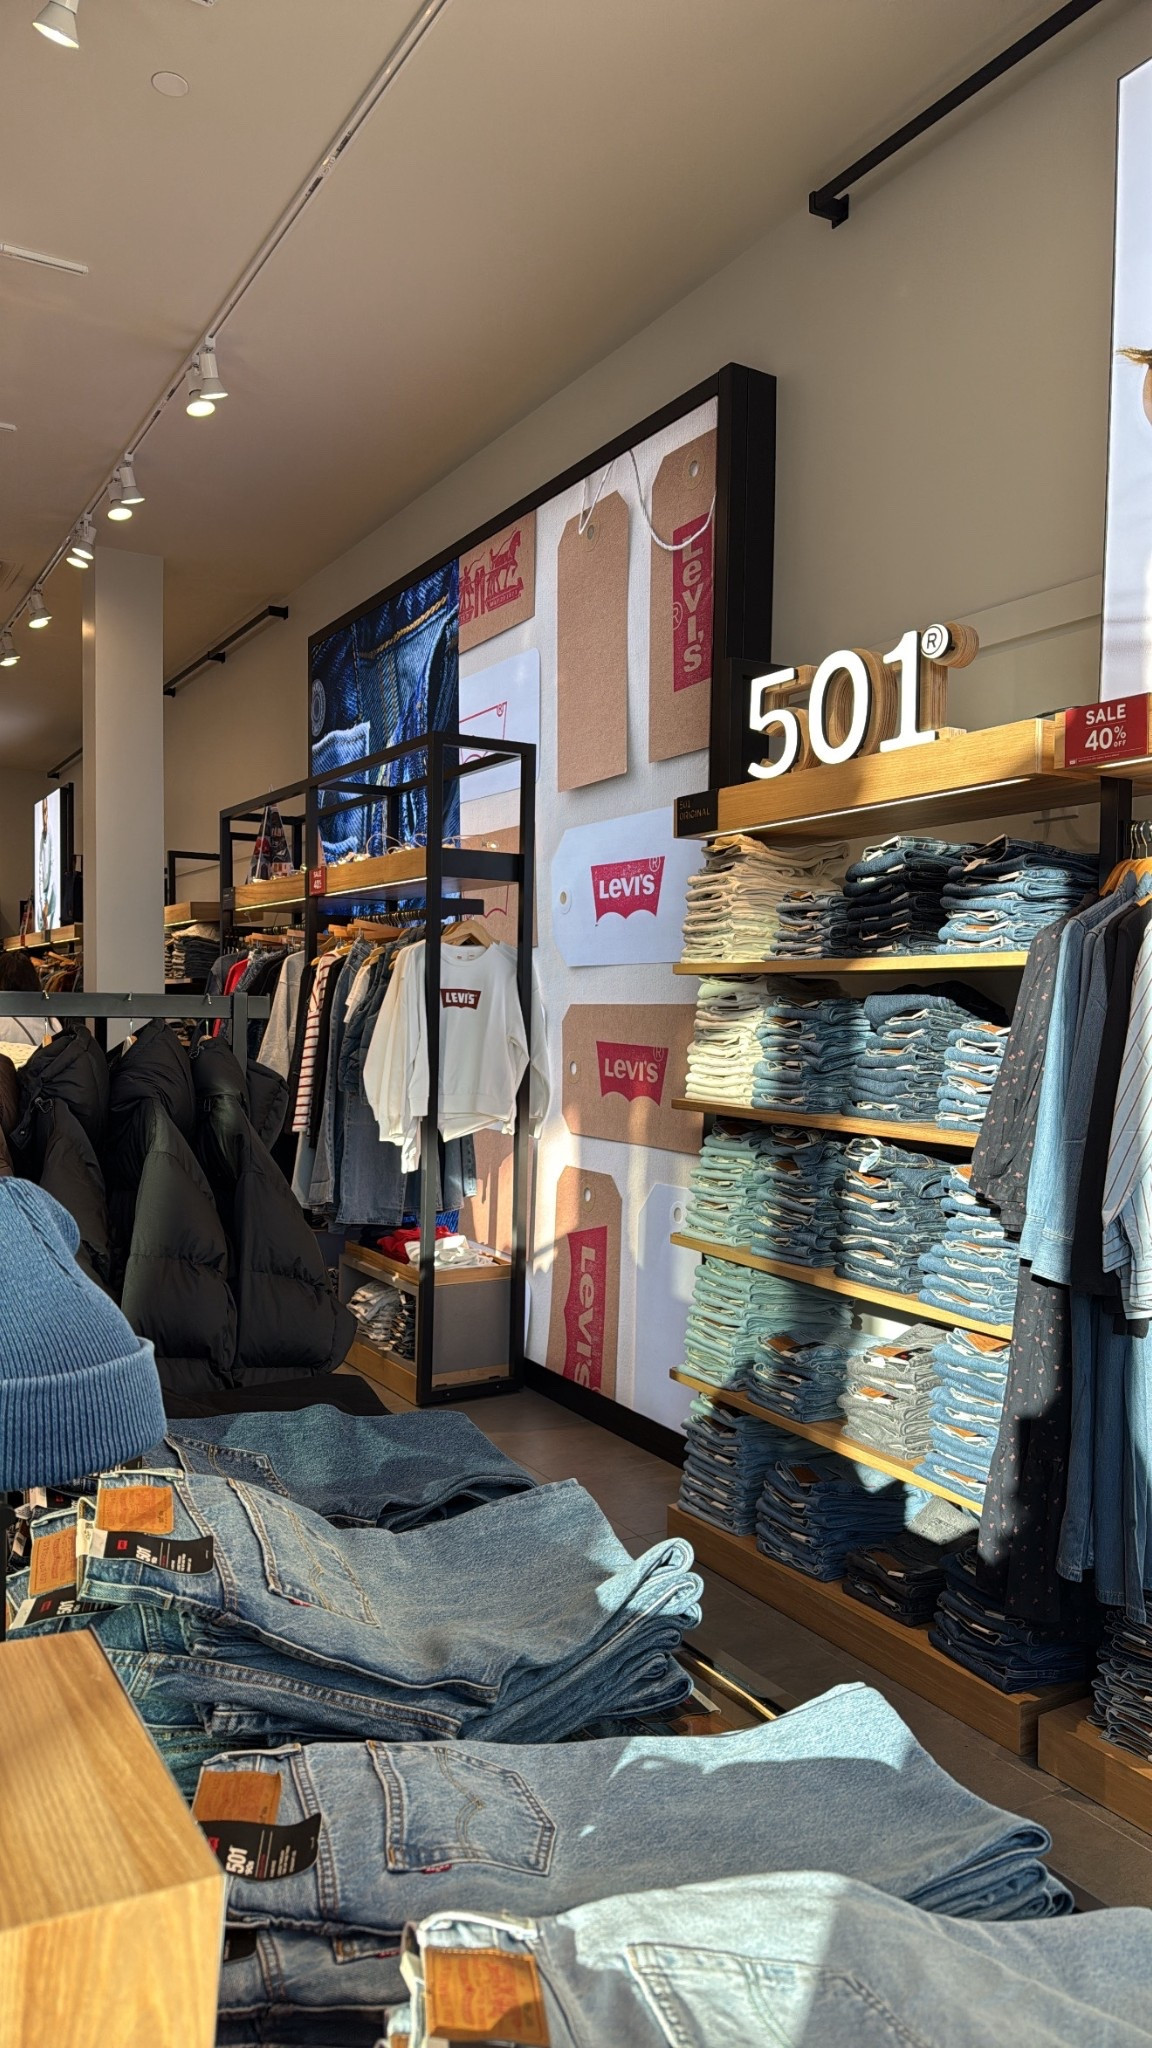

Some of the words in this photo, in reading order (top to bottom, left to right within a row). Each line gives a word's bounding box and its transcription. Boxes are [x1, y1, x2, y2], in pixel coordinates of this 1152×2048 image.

[1085, 703, 1126, 725] SALE
[1113, 739, 1126, 748] OFF
[679, 807, 711, 820] ORIGINAL
[225, 1844, 248, 1875] 501
